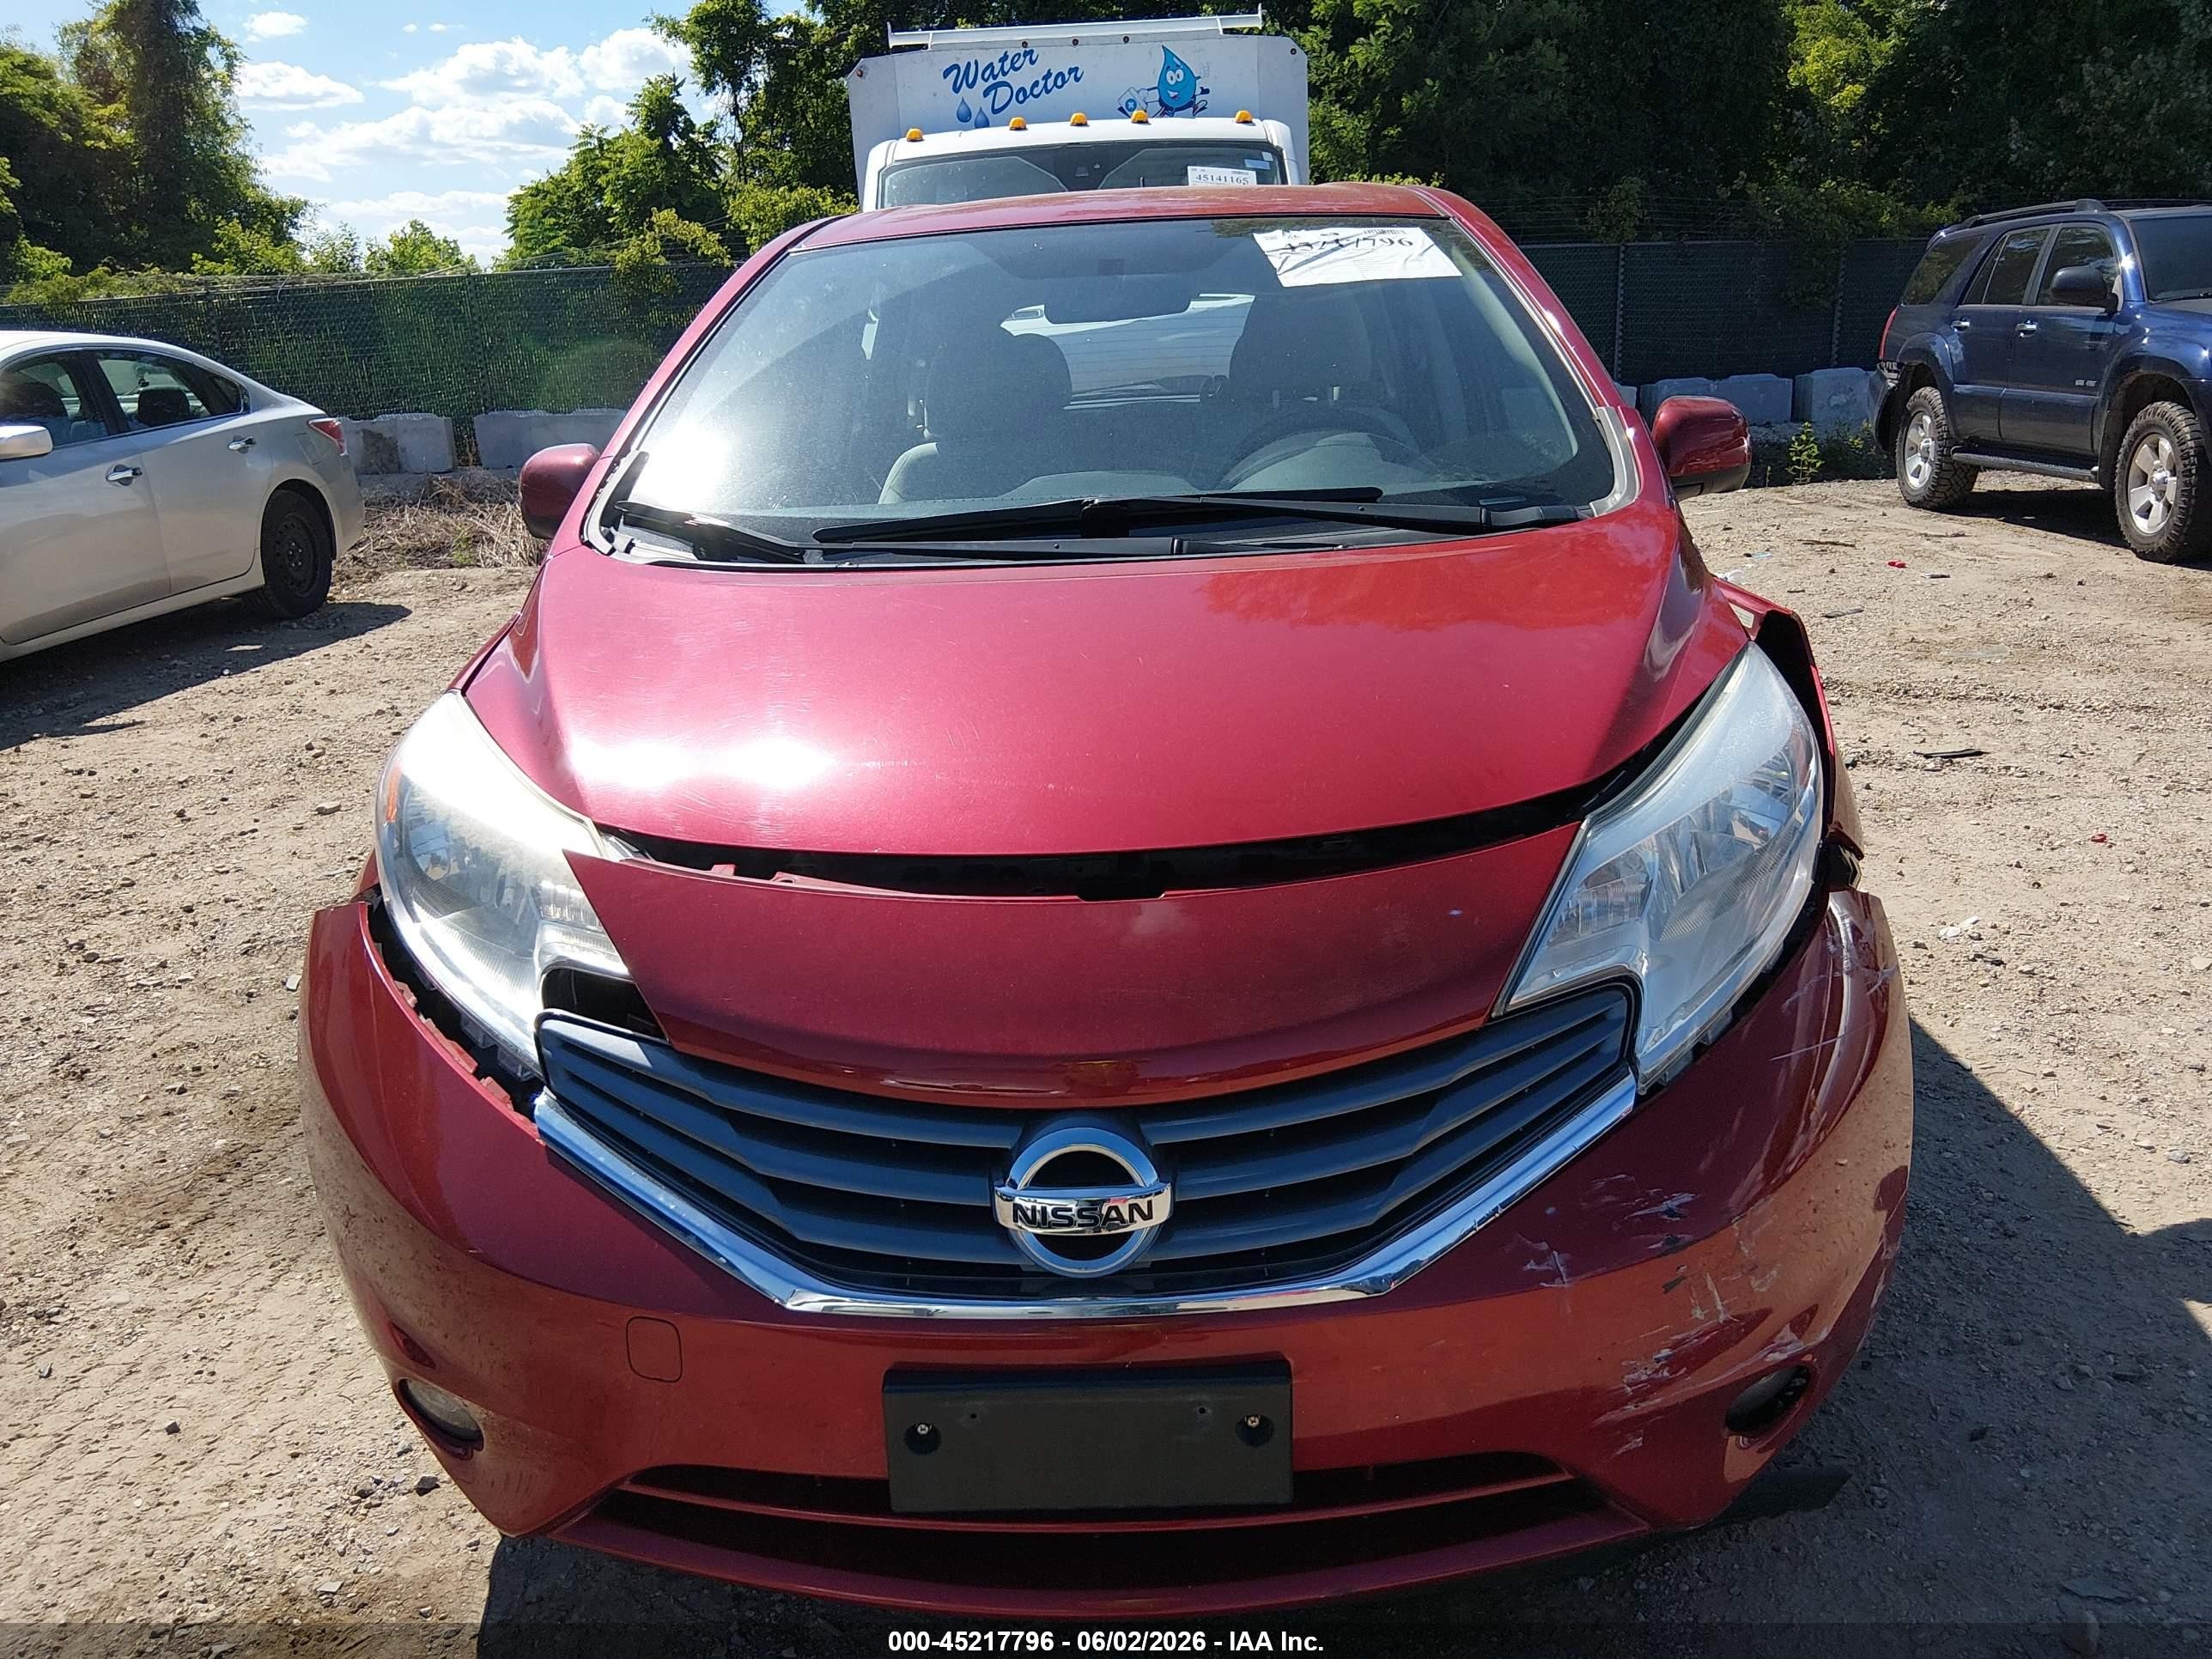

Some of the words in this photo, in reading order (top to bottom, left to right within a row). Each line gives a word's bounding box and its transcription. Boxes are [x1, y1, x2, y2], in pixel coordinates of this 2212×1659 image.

[942, 48, 1039, 94] Water
[982, 66, 1085, 115] Doctor
[1195, 173, 1249, 185] 45141165
[1012, 1200, 1154, 1228] NISSAN
